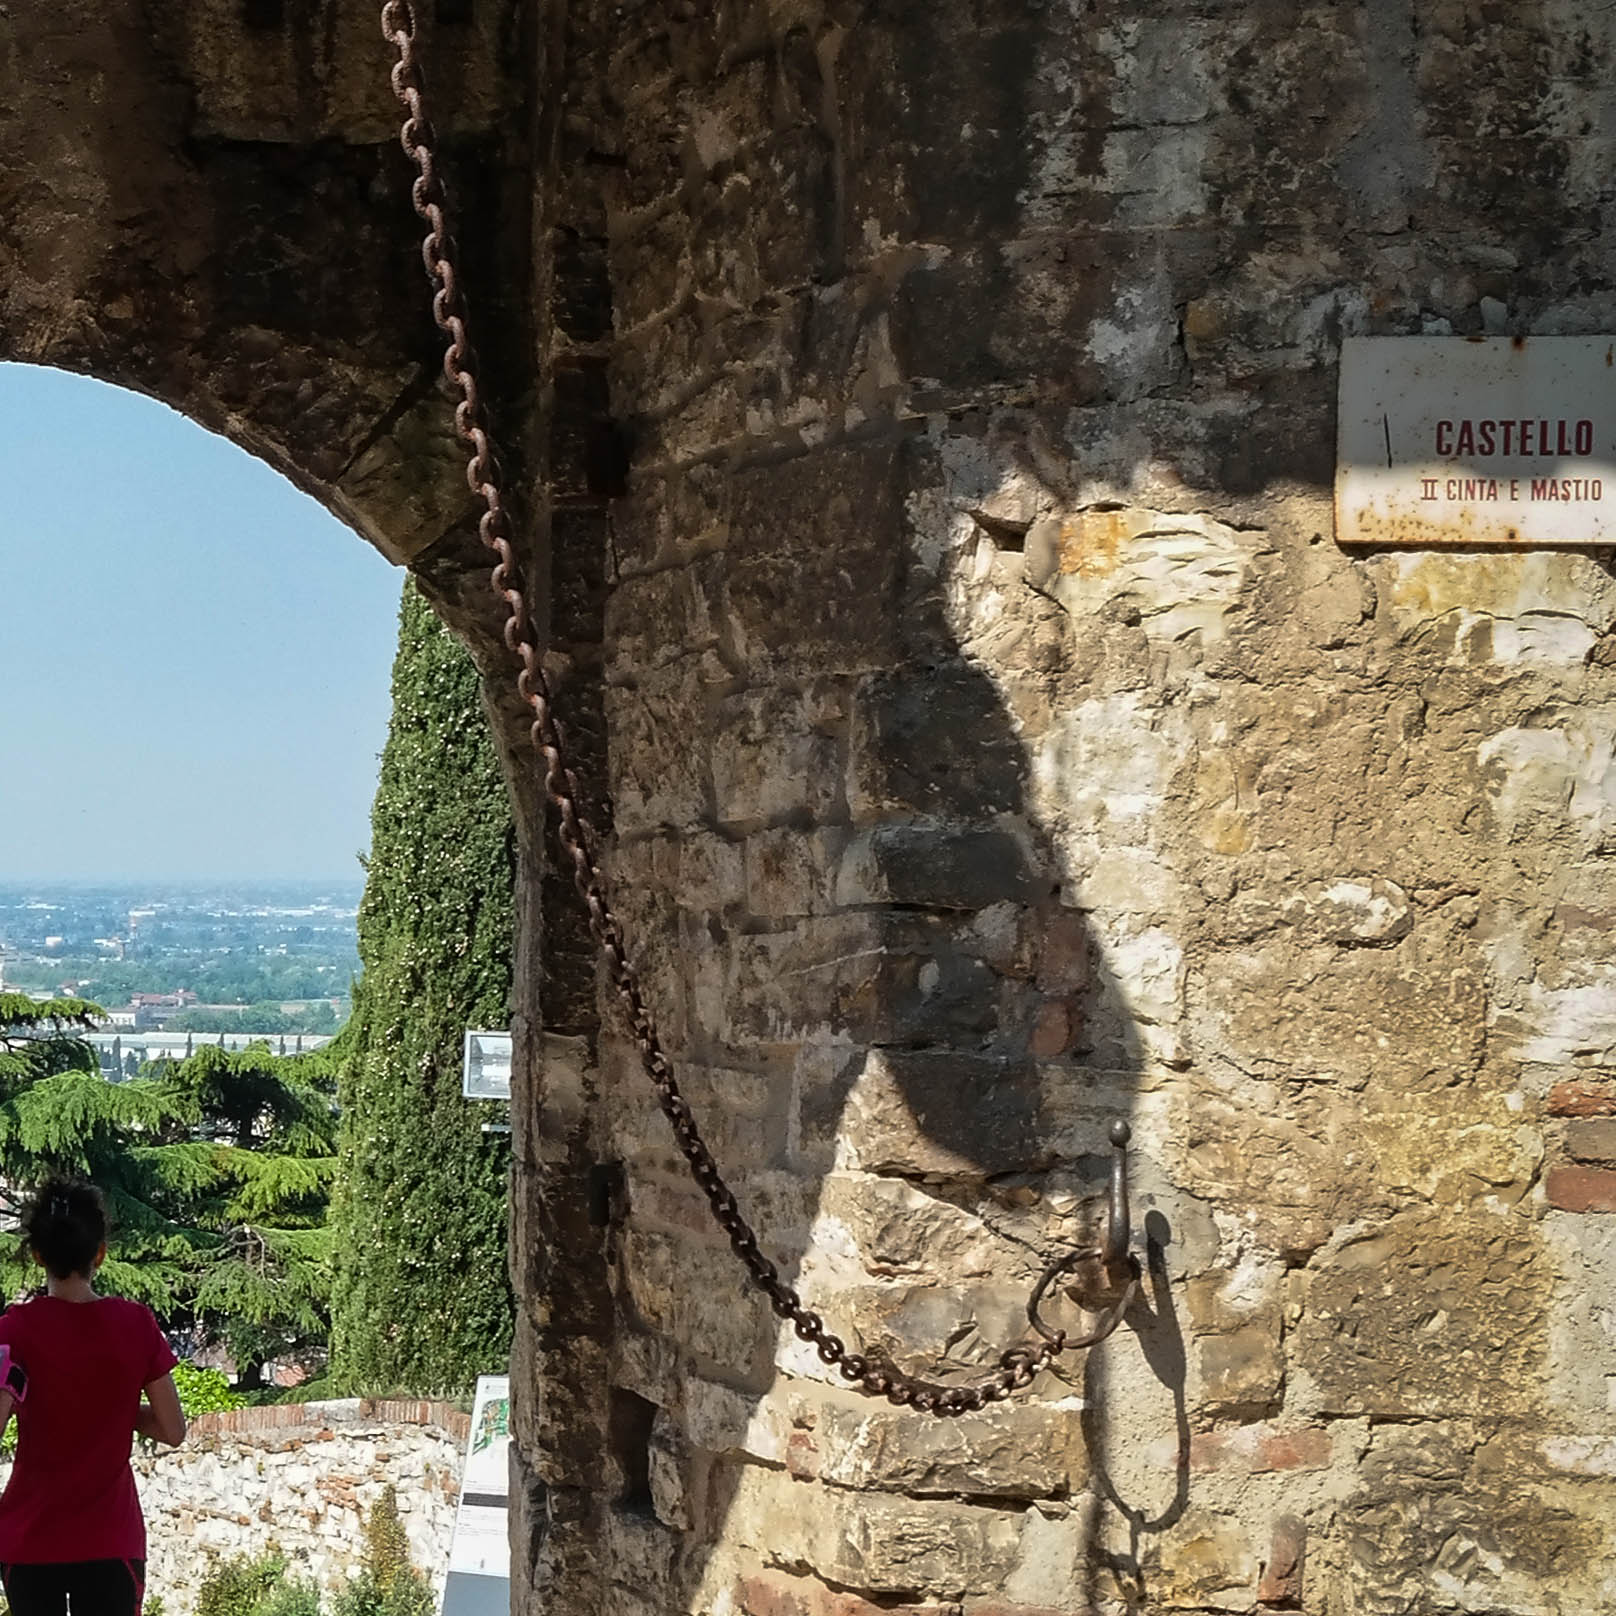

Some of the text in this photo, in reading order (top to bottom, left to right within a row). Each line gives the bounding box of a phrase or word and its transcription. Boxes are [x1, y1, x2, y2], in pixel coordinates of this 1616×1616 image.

[1436, 420, 1593, 456] CASTELLO
[1421, 479, 1602, 501] II CINTA E MASTIO
